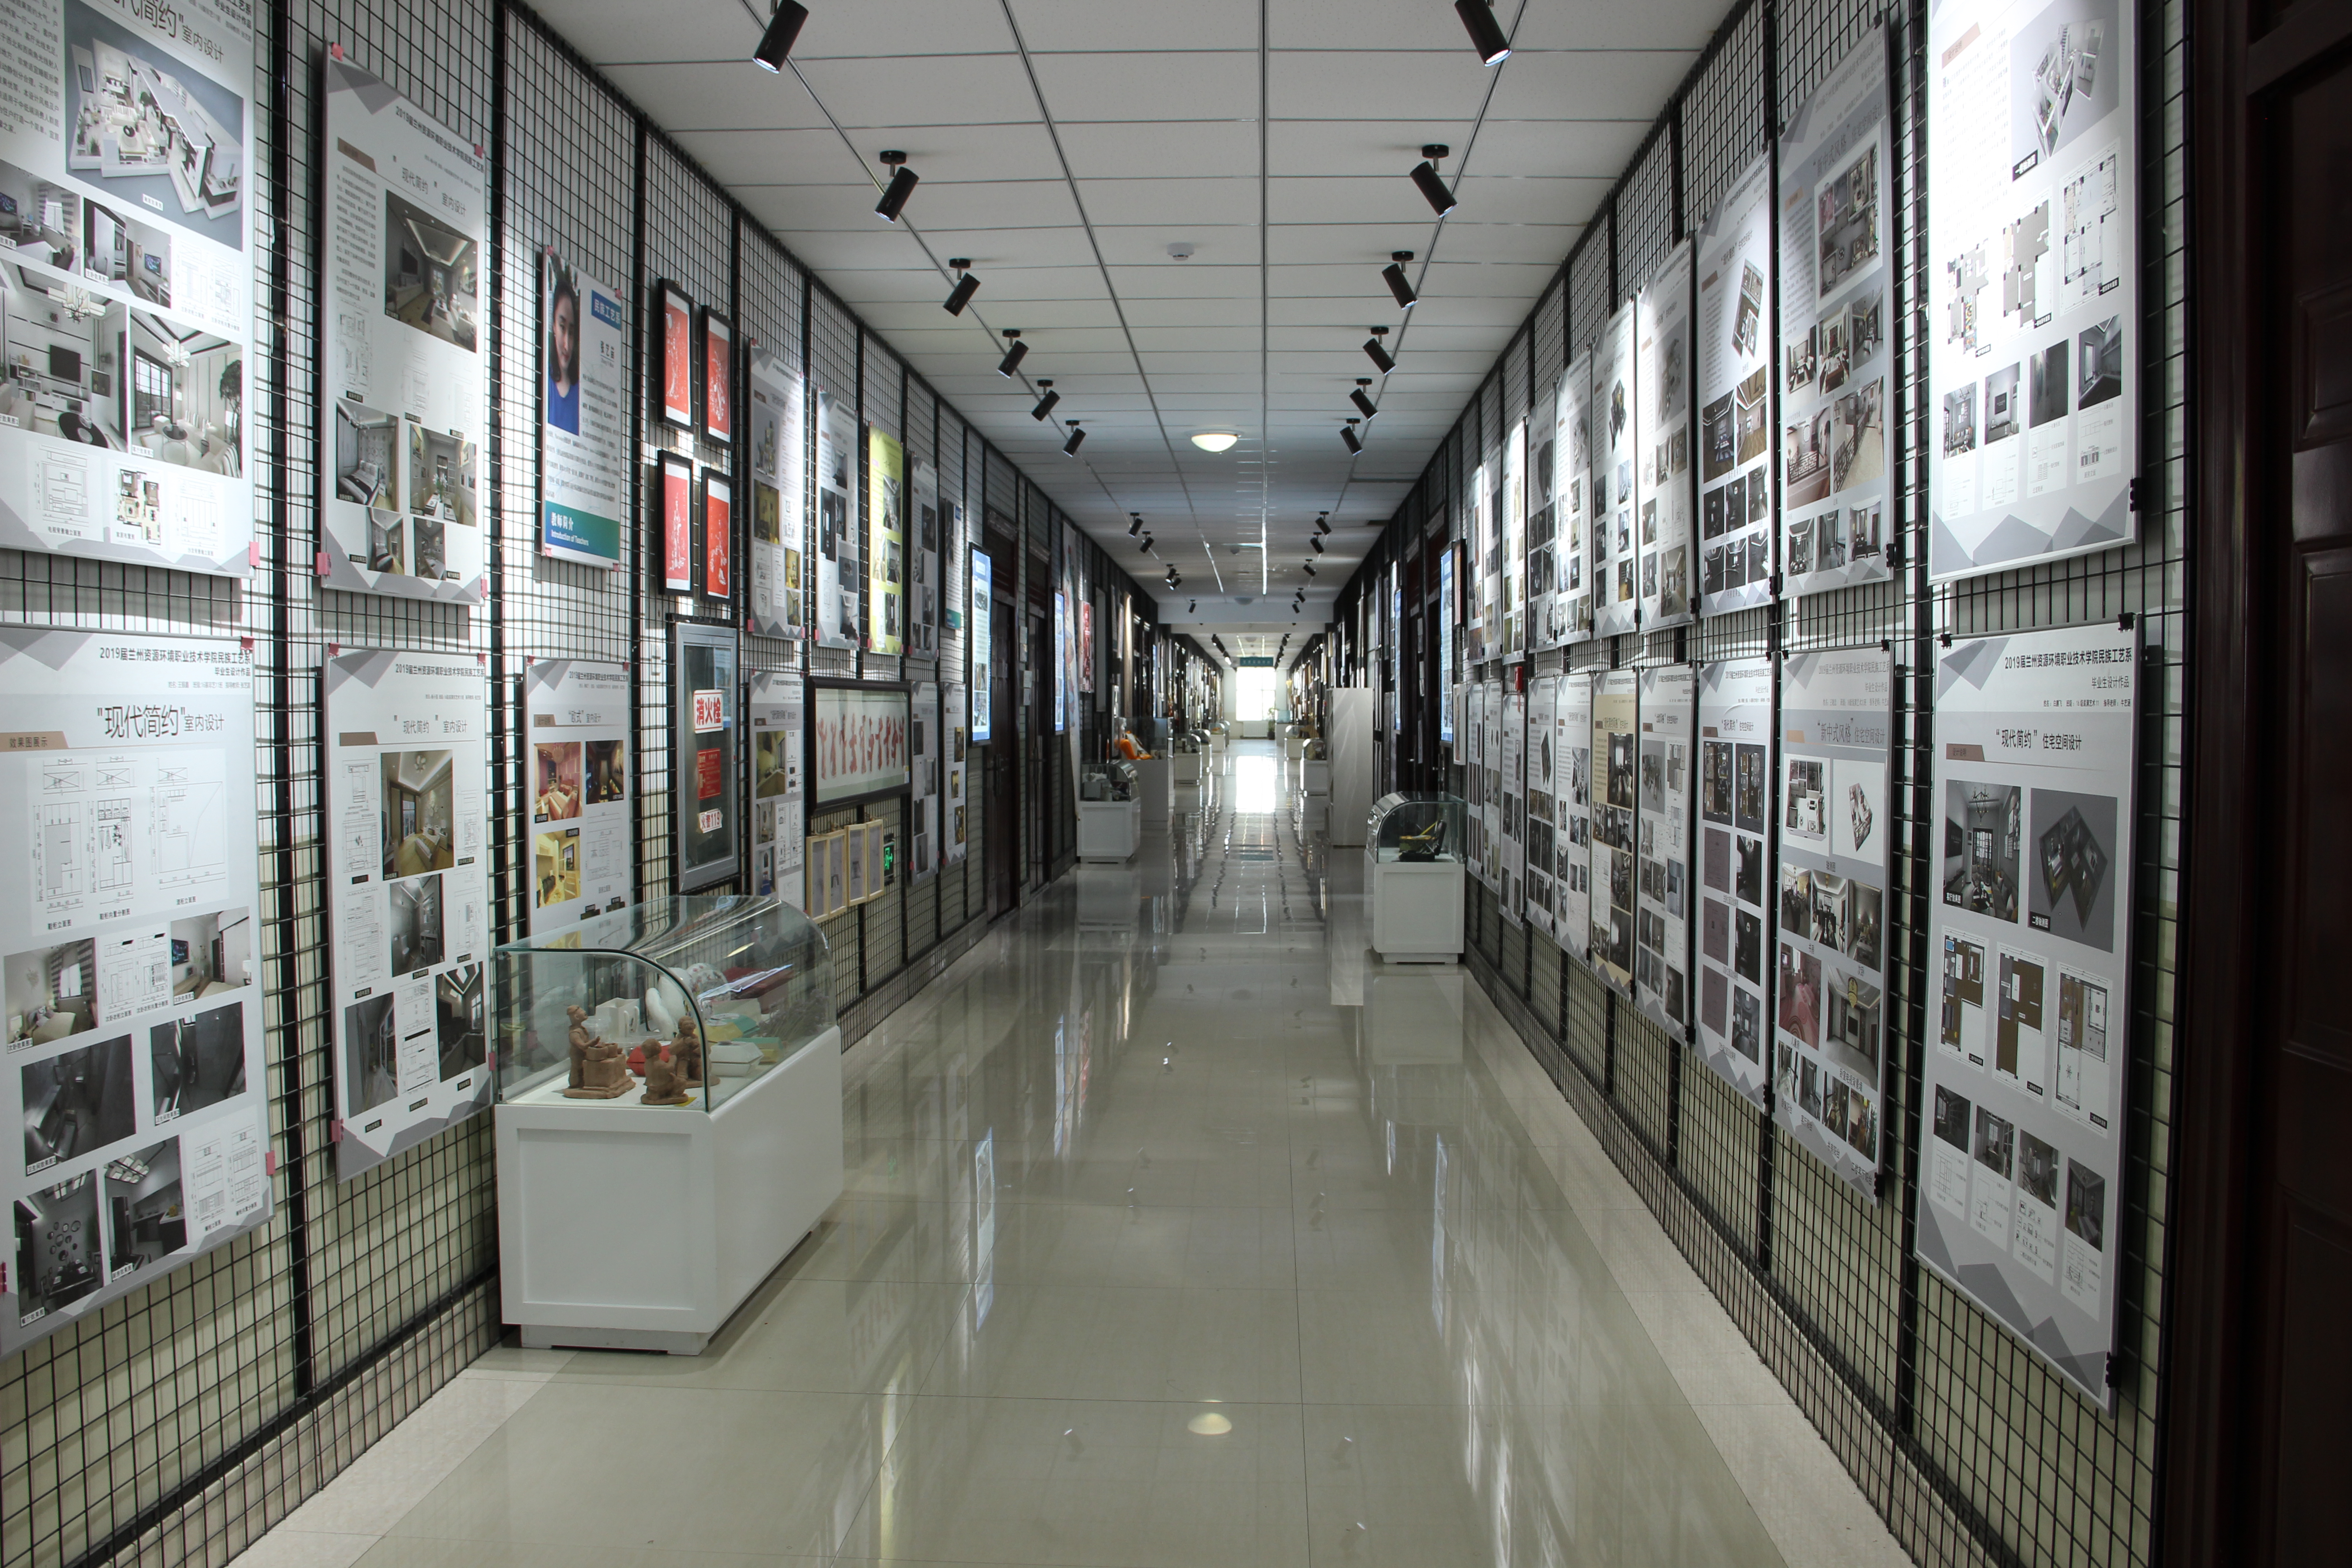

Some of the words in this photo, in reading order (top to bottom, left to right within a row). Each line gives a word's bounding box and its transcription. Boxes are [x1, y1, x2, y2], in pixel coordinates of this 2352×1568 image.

[550, 511, 574, 531] 教师简介
[551, 529, 571, 542] Introduction
[100, 647, 252, 665] 2019届兰州资源环境职业技术学院民族工艺系
[2004, 647, 2132, 670] 2019届兰州资源环境职业技术学院民族工艺系
[215, 667, 251, 676] 毕业生设计作品
[2091, 676, 2130, 689] 毕业生设计作品
[696, 697, 721, 725] 消火栓
[443, 720, 468, 734] 室内设计
[1855, 726, 1885, 745] 住宅空间设计
[10, 737, 48, 748] 效果图展示
[2043, 735, 2082, 751] 住宅空间设计
[701, 811, 720, 829] 火警119
